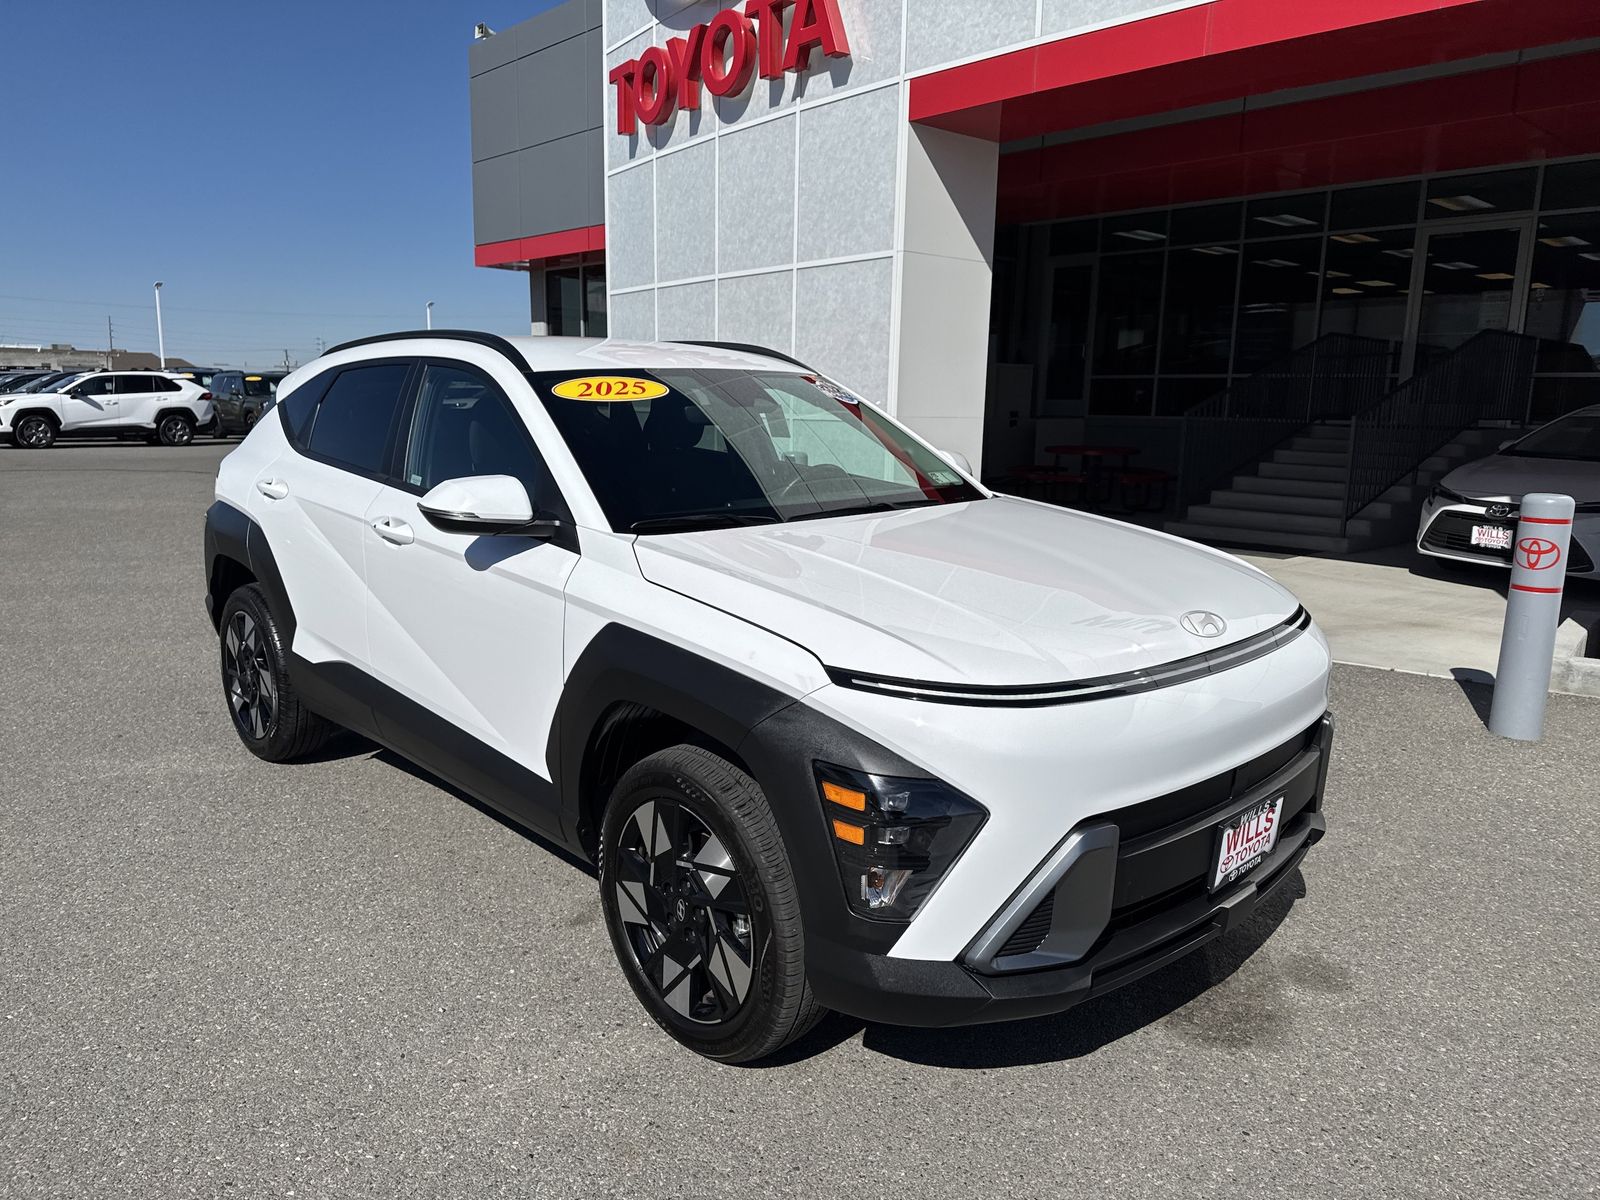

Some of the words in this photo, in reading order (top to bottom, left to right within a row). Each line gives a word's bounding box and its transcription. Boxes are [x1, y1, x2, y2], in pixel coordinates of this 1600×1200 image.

[609, 0, 851, 136] TOYOTA
[577, 381, 646, 397] 2025
[1477, 529, 1509, 540] WILLS
[1240, 801, 1271, 826] WILLS
[1227, 807, 1275, 855] WILLS
[1235, 833, 1271, 864] TOYOTA
[1238, 855, 1262, 876] TOYOTA
